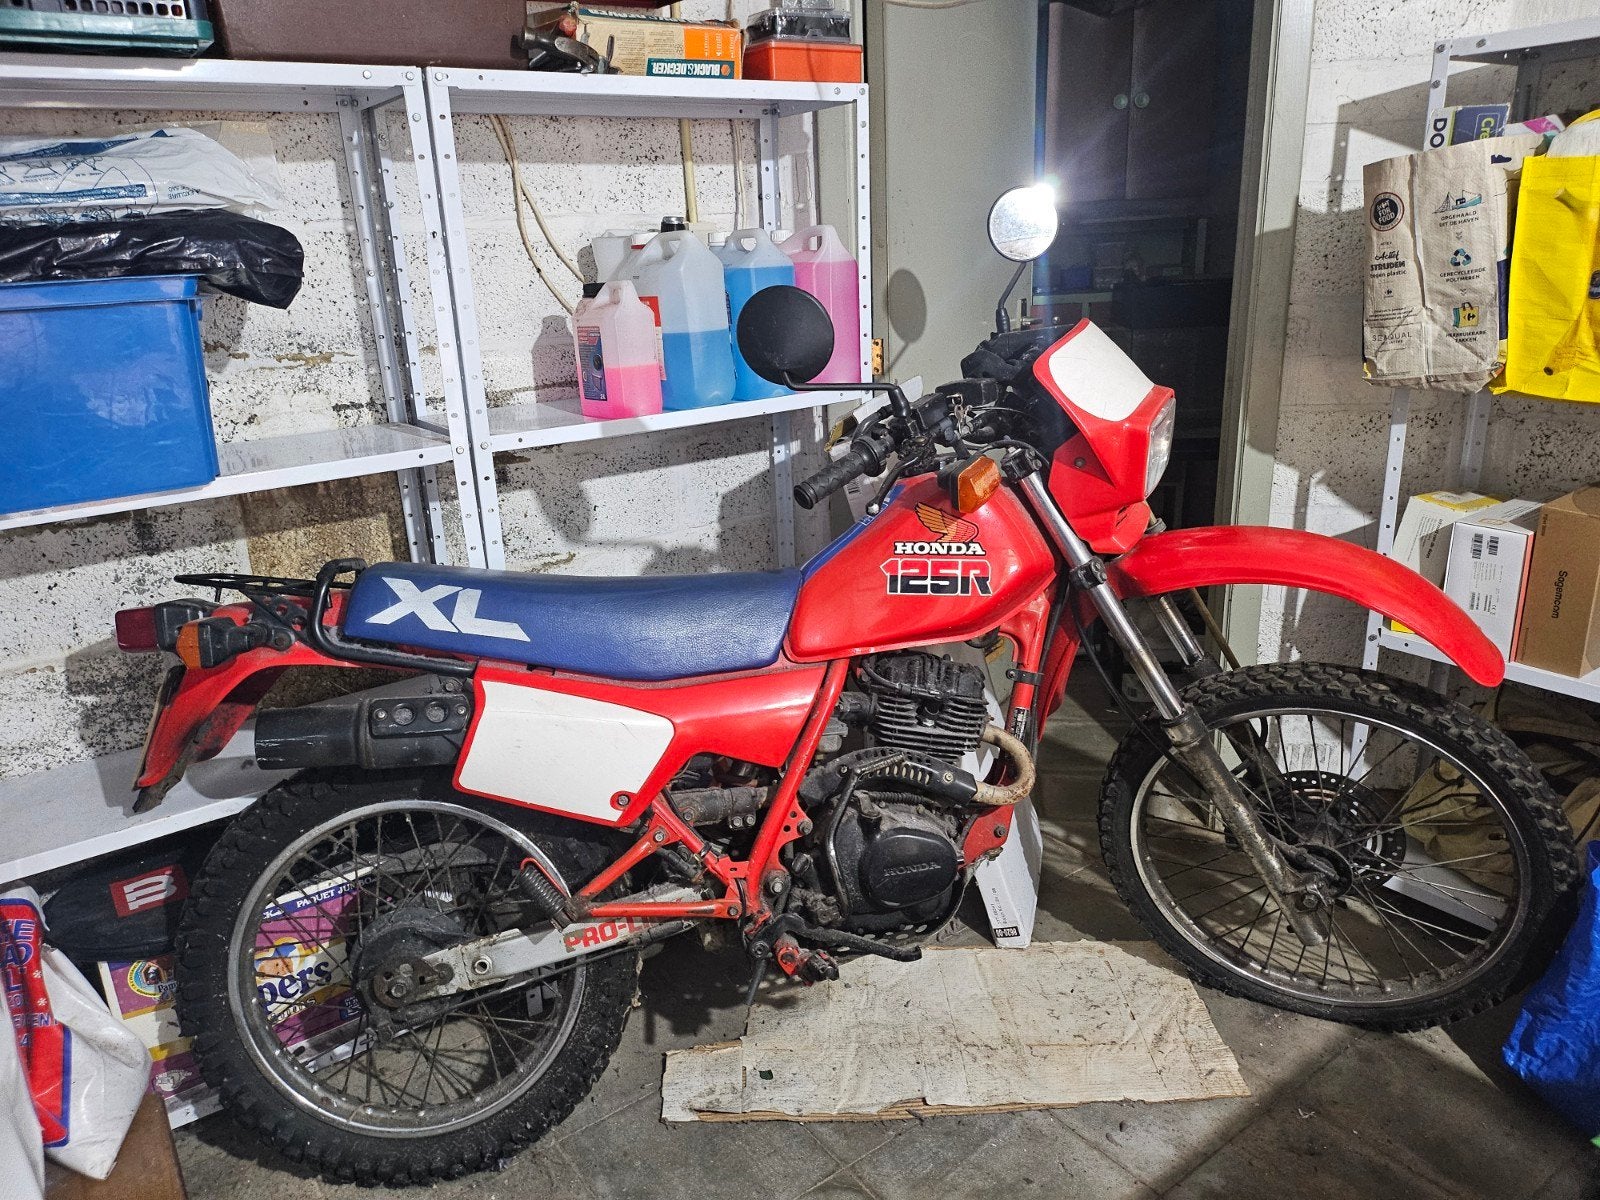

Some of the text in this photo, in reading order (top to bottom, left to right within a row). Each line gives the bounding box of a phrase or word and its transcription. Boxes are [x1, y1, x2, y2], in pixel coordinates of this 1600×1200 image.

[894, 541, 986, 555] HONDA
[880, 558, 993, 596] 125R
[1551, 570, 1568, 619] Sagemcom
[365, 576, 531, 642] XL
